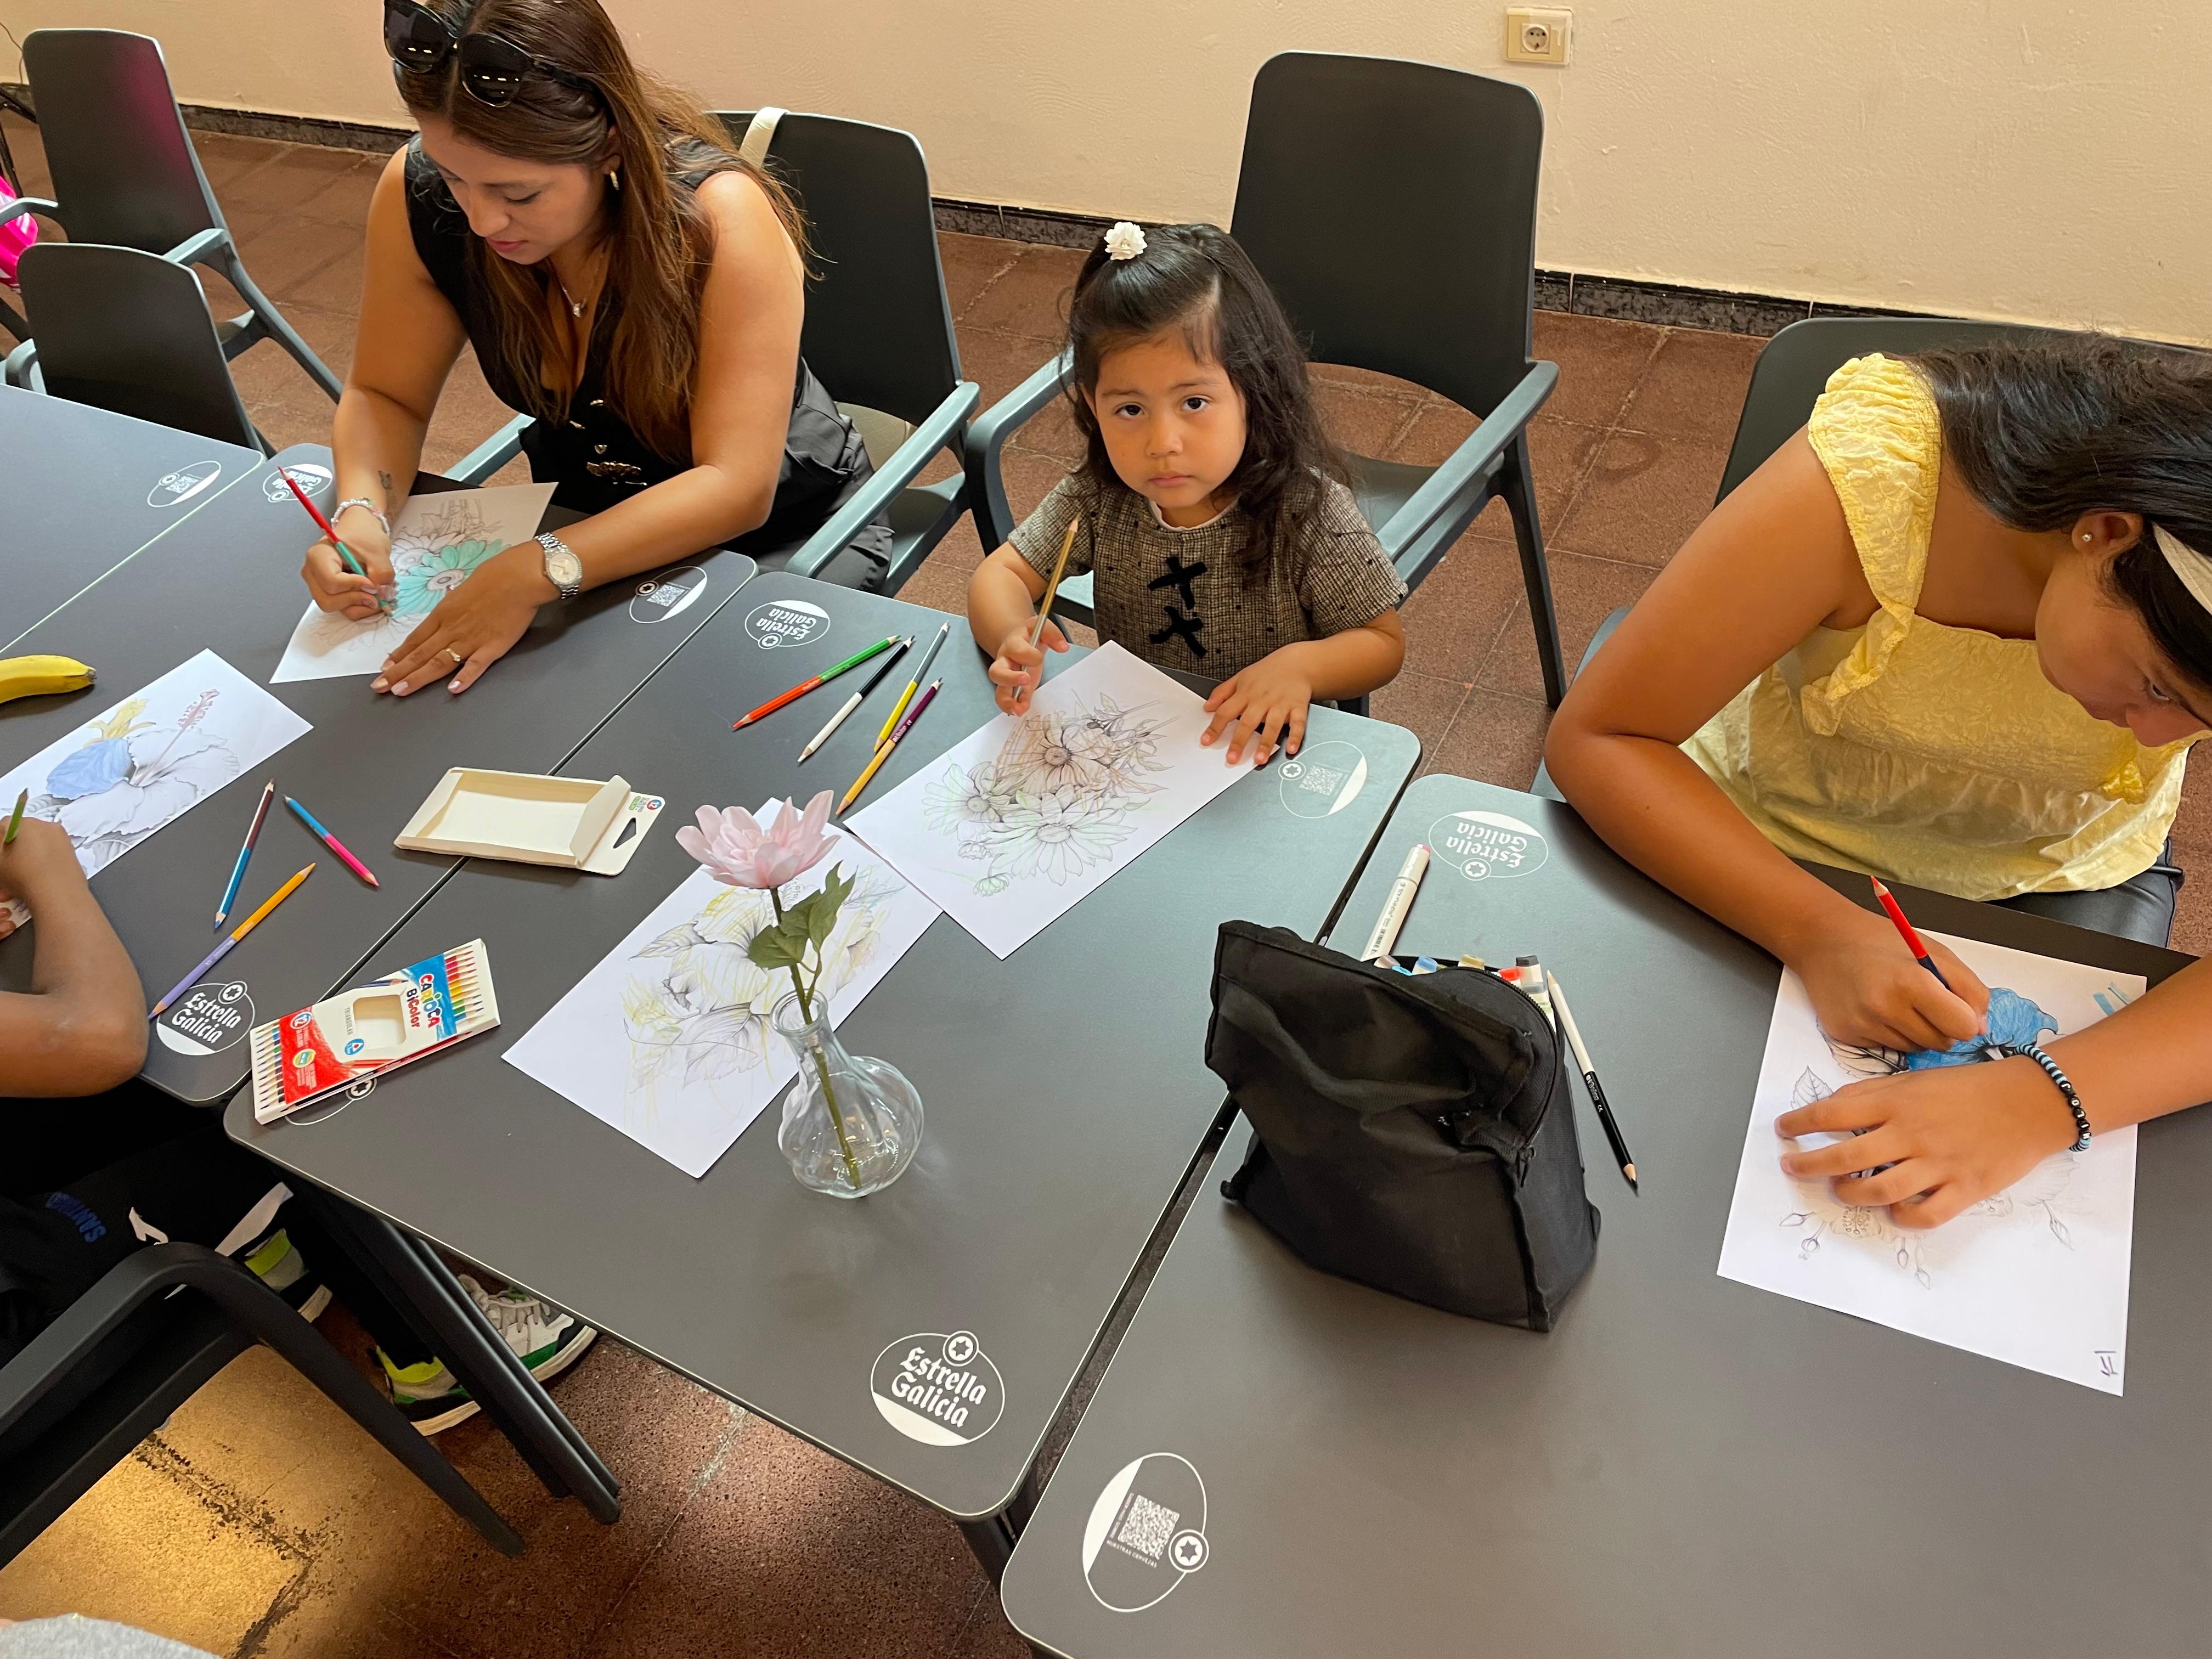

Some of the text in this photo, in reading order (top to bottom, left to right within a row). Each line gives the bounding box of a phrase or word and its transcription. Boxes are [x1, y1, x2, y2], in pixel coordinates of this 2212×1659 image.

[756, 618, 811, 640] Estrella
[769, 608, 817, 629] Galicia
[1446, 836, 1526, 868] Estrella
[1457, 822, 1528, 852] Galicia
[184, 992, 241, 1029] Estrella
[419, 974, 442, 1028] CARIOCA
[172, 1008, 223, 1043] Galicia
[900, 1346, 987, 1405] Estrella
[891, 1371, 969, 1427] Galicia
